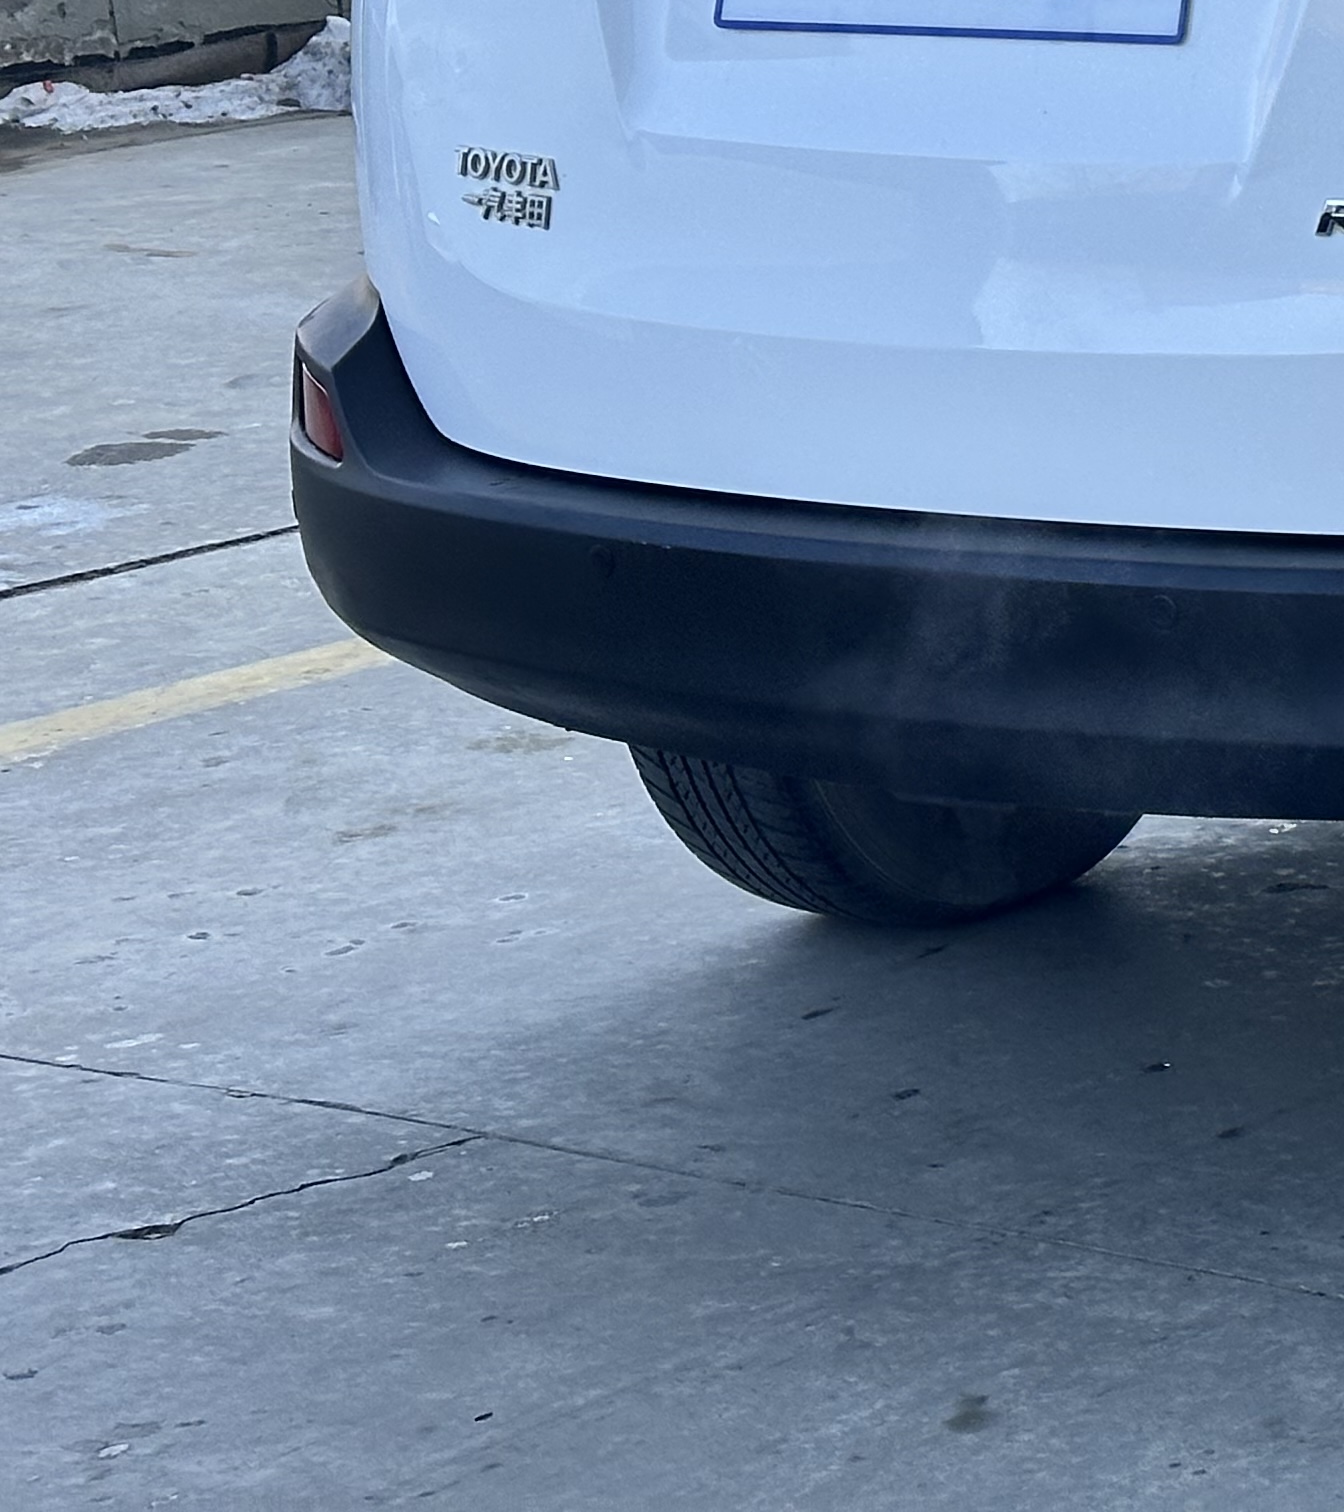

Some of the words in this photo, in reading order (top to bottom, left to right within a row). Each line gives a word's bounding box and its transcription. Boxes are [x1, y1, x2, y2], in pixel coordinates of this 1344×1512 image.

[455, 145, 560, 191] TOYOTA
[461, 187, 552, 231] 一汽丰田
